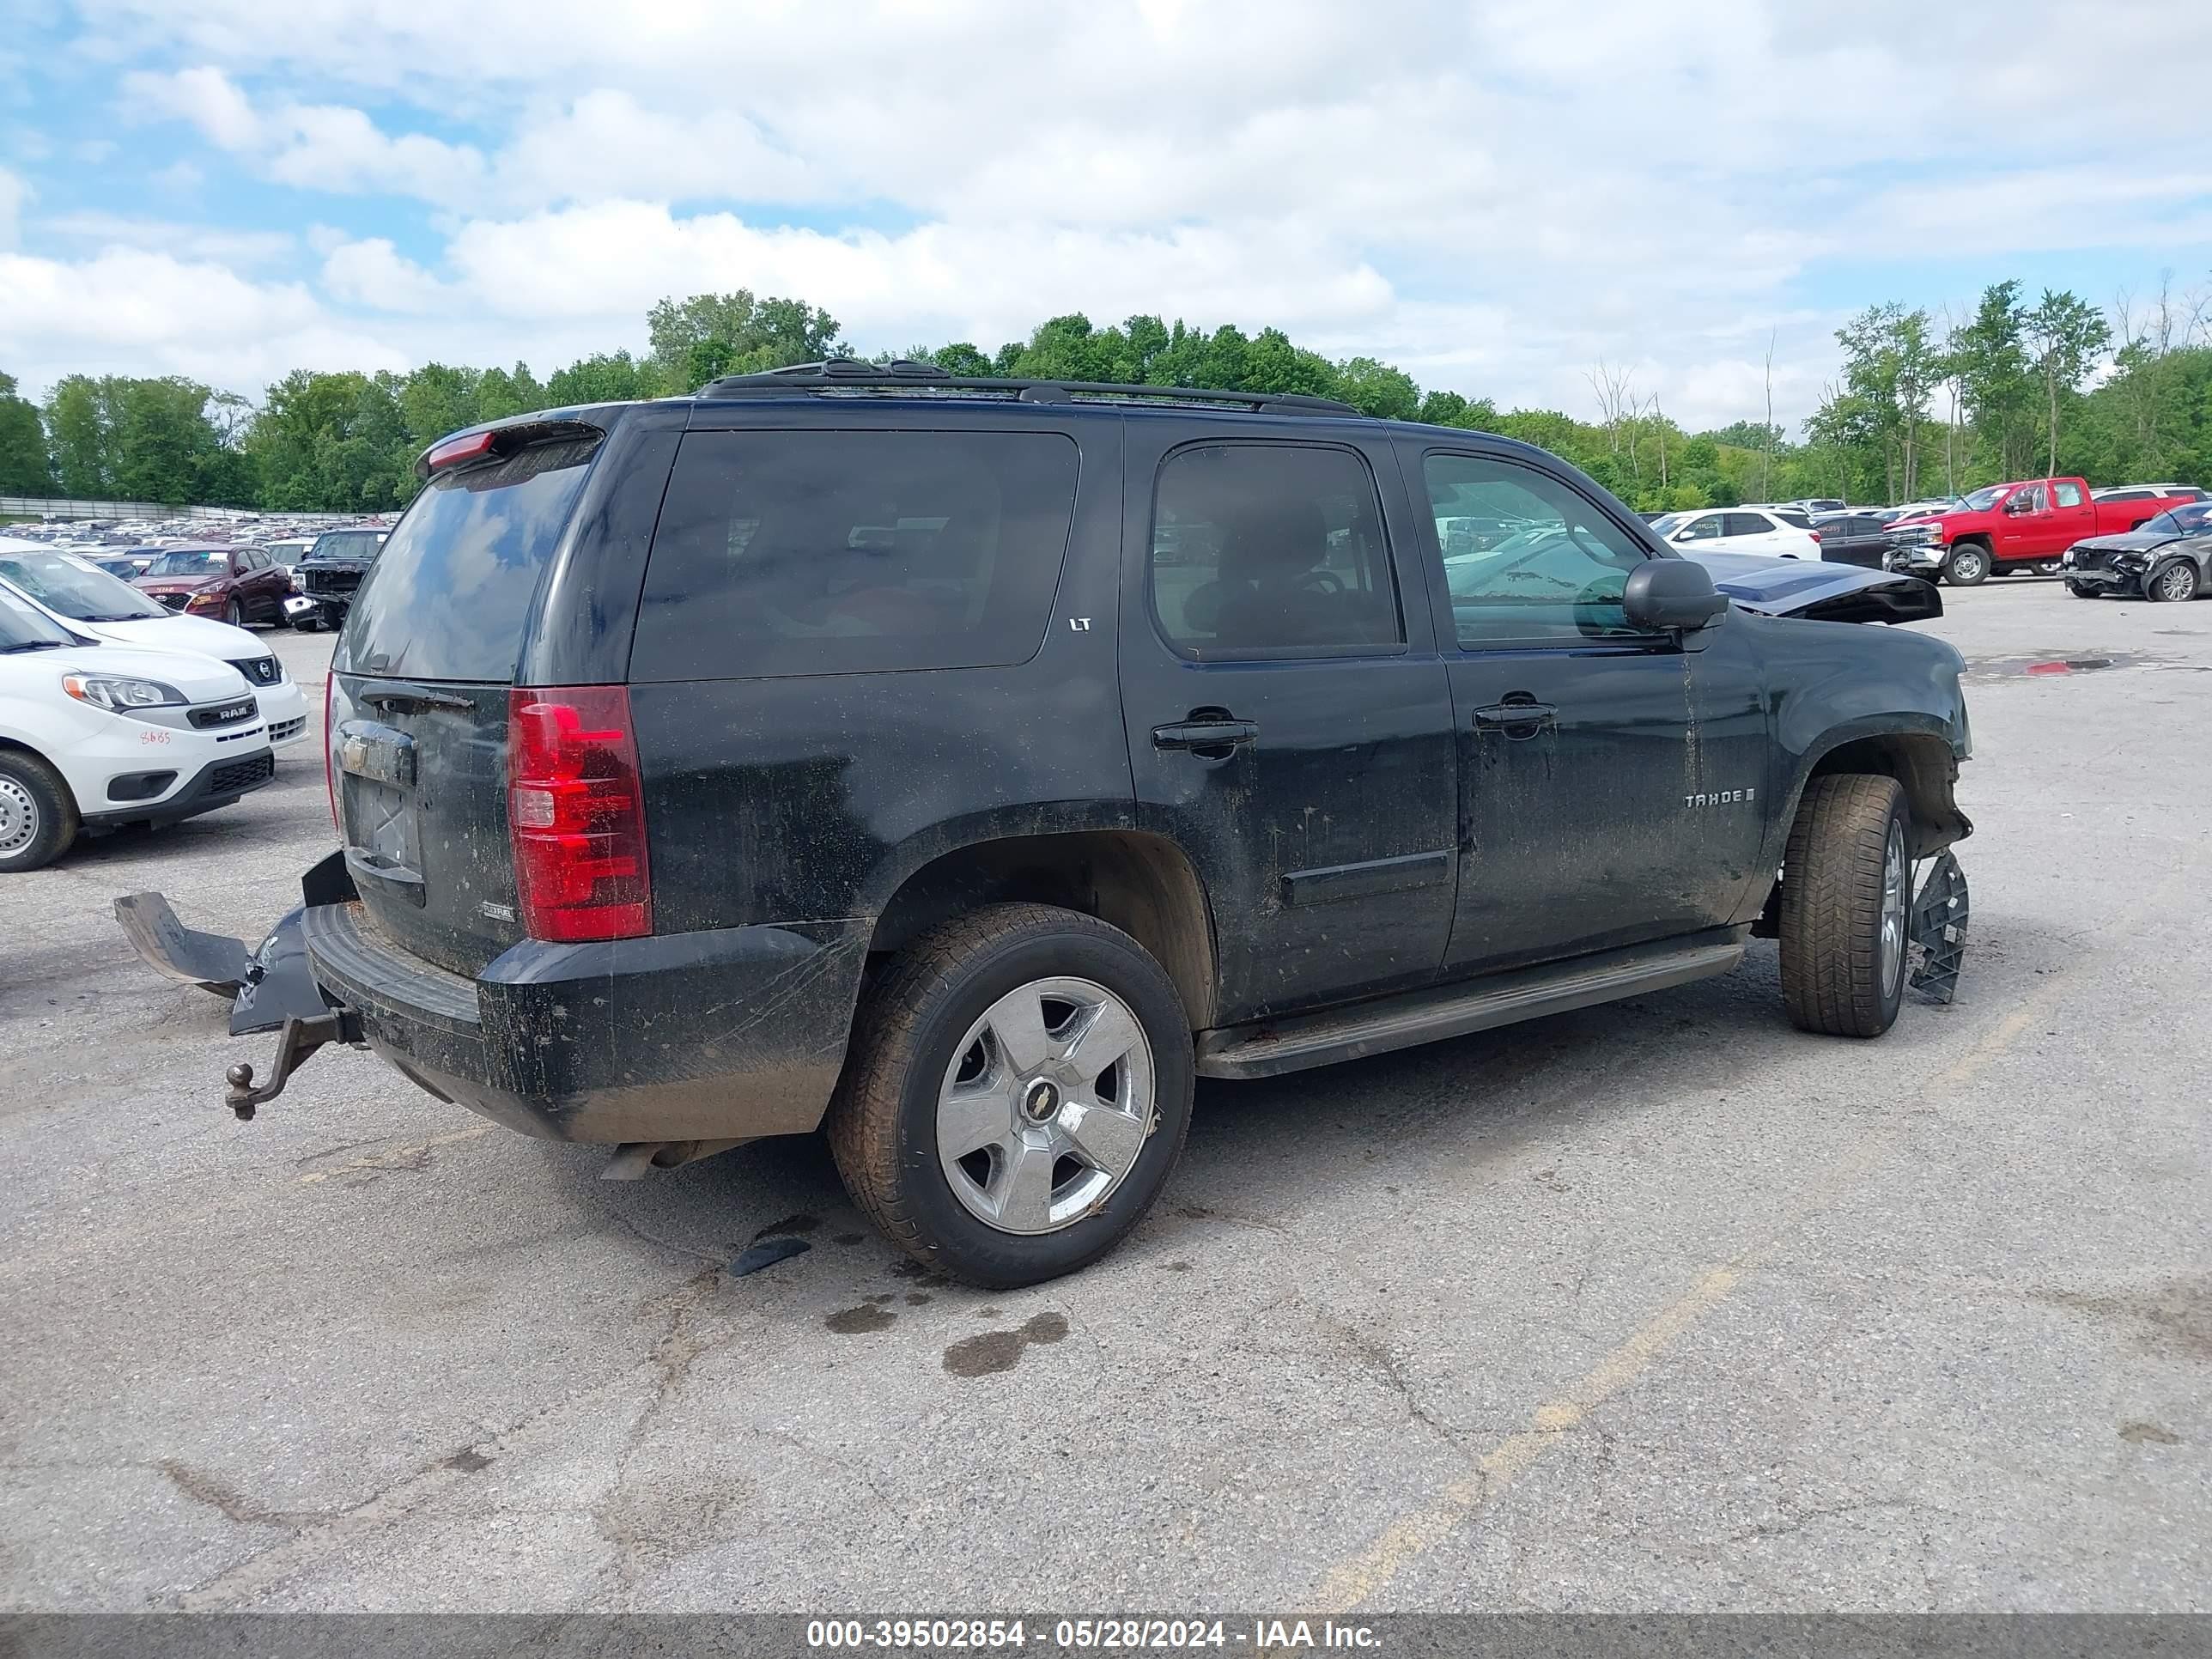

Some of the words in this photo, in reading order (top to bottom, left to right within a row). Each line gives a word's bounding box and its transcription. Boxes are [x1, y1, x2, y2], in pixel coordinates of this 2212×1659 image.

[1068, 617, 1091, 632] LT
[219, 706, 248, 720] RAM
[139, 731, 172, 745] 8685
[1685, 789, 1742, 808] TAHOE
